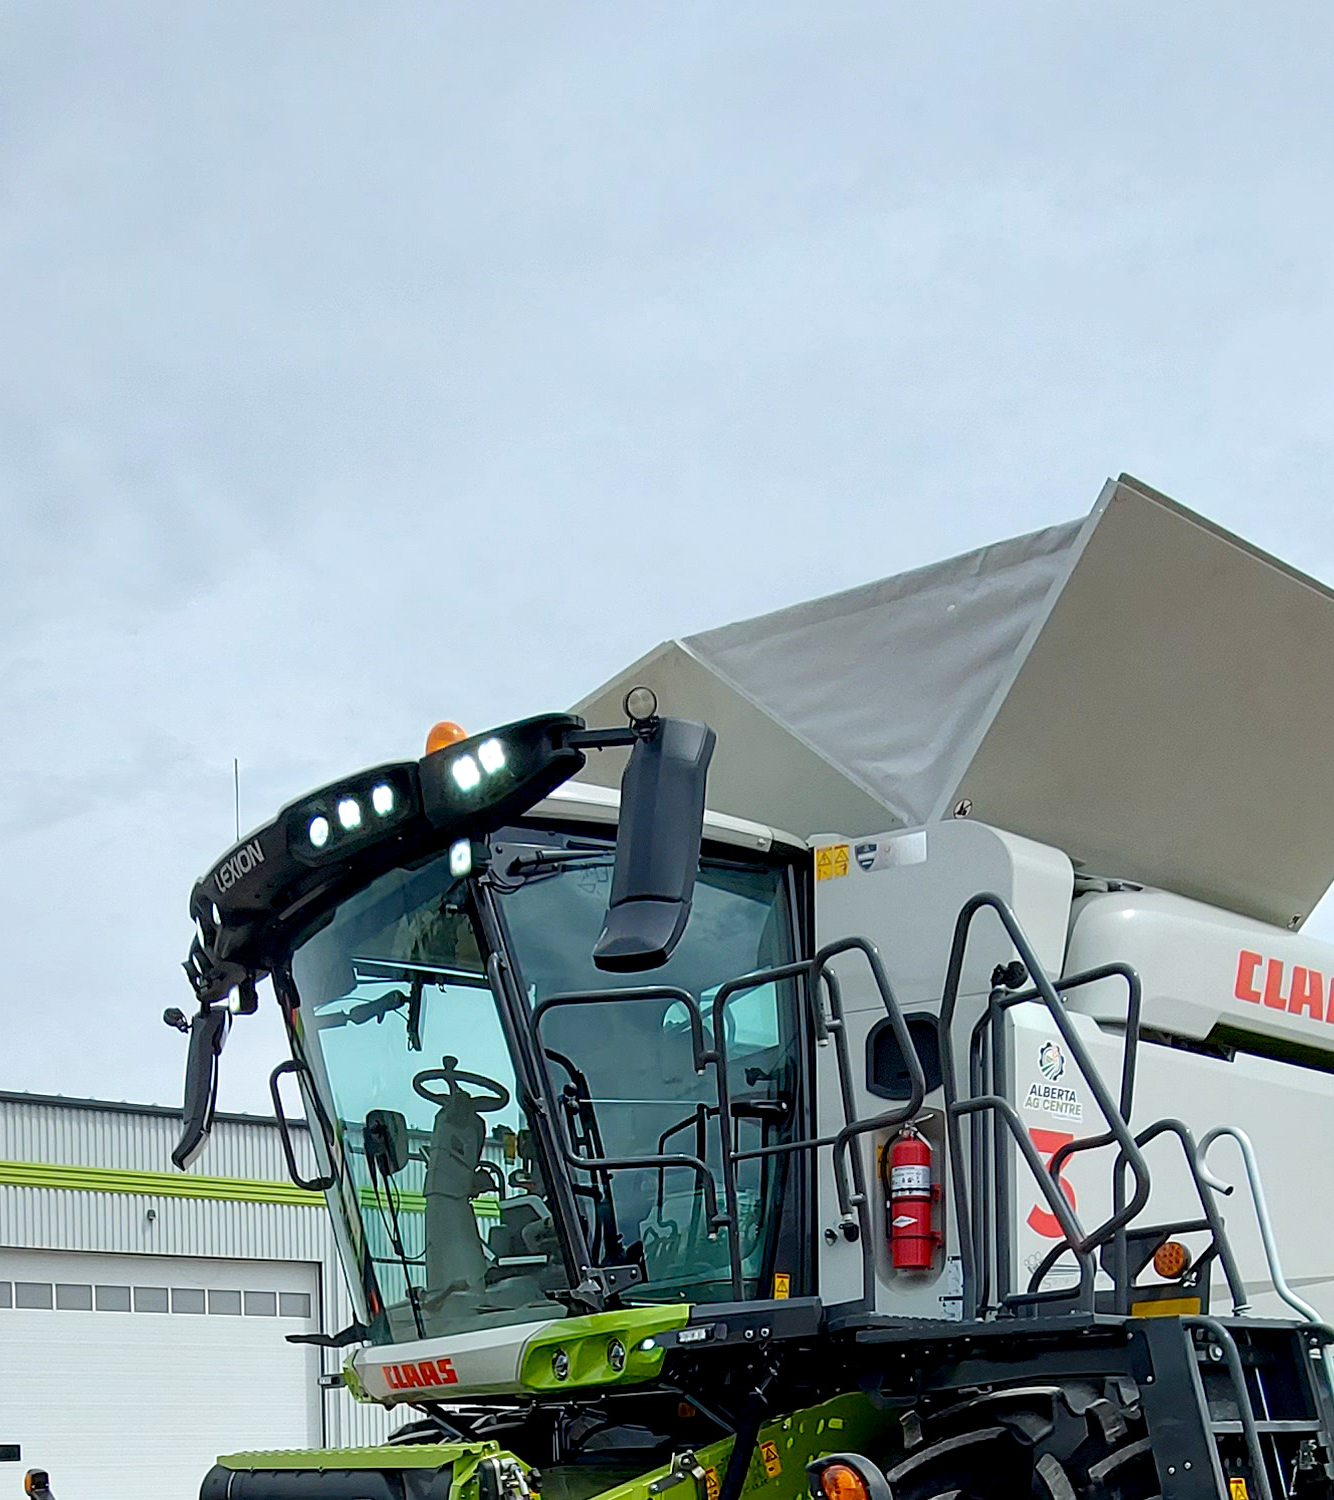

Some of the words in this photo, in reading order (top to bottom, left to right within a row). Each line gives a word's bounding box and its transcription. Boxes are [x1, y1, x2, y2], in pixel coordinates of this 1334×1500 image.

[214, 839, 265, 893] LEXION
[1025, 1096, 1040, 1109] AG
[1042, 1099, 1082, 1116] CENTRE
[1029, 1084, 1077, 1102] ALBERTA
[1027, 1127, 1077, 1239] 3
[381, 1358, 459, 1390] CLAAS
